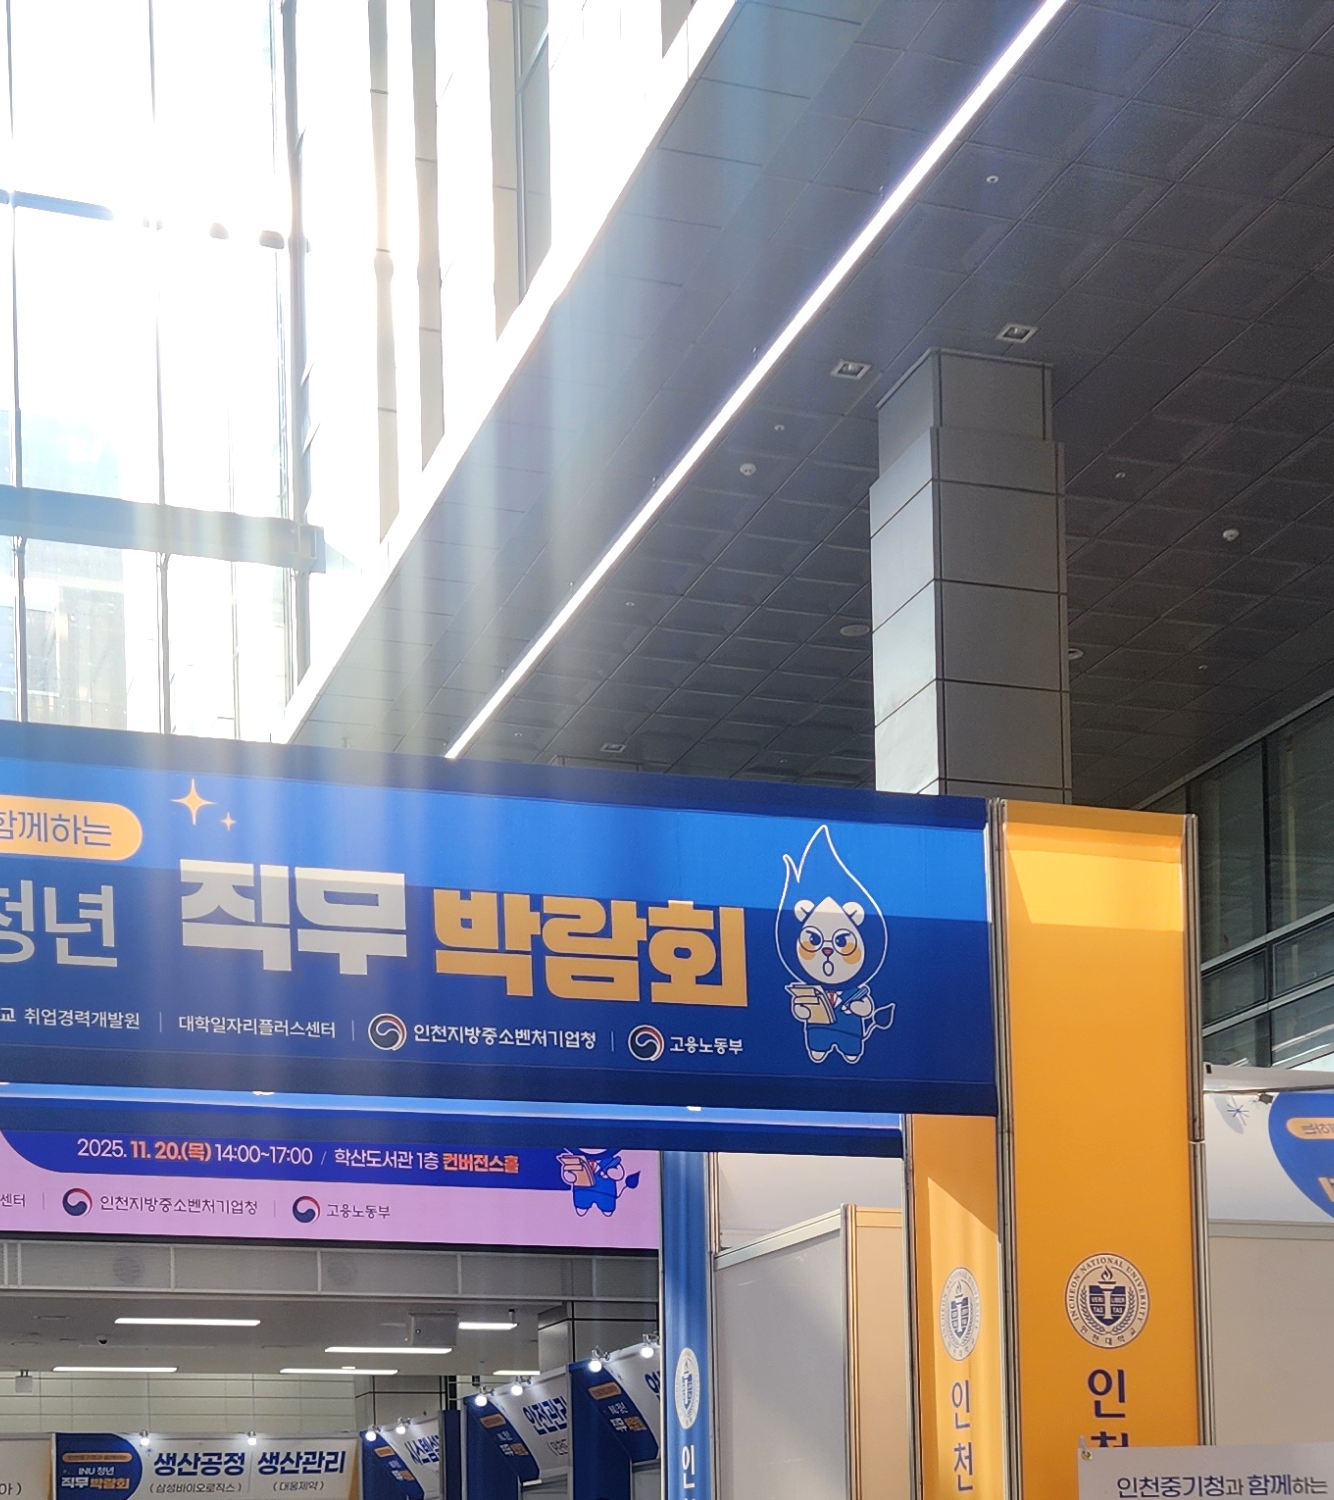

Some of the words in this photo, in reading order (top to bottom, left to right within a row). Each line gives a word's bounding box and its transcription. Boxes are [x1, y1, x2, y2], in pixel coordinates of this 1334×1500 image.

[180, 859, 407, 975] 직무
[433, 889, 748, 1008] 박람회
[24, 1007, 140, 1030] 취업경력개발원
[179, 1014, 336, 1039] 대학일자리플러스센터
[413, 1022, 597, 1050] 인천지방중소벤처기업청
[669, 1034, 744, 1056] 고용노동부
[77, 1138, 128, 1158] 2025.
[130, 1141, 150, 1158] 11.
[154, 1142, 212, 1162] 20.(목)
[214, 1144, 313, 1166] 14:00~17:00
[334, 1148, 413, 1169] 학산도서관
[416, 1151, 439, 1171] 1층
[443, 1153, 520, 1175] 컨버전스홀
[99, 1194, 258, 1216] 인천지방중소벤처기업청
[326, 1203, 391, 1219] 고용노동부
[154, 1452, 245, 1477] 생산공정
[258, 1451, 347, 1475] 생산관리
[1117, 1476, 1244, 1498] 인천중기청과
[1247, 1474, 1328, 1495] 함께하는
